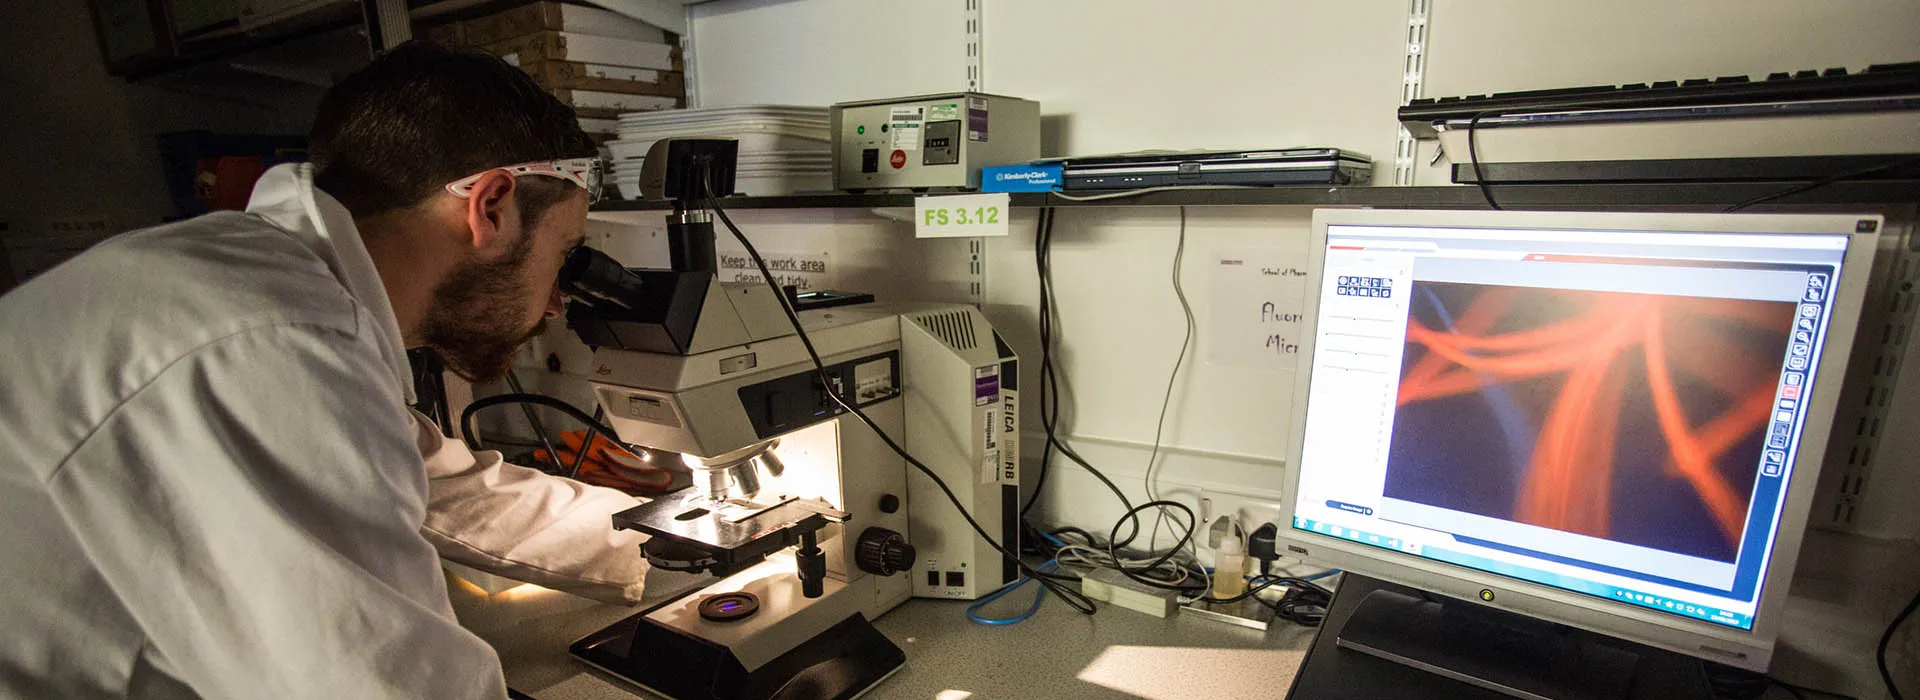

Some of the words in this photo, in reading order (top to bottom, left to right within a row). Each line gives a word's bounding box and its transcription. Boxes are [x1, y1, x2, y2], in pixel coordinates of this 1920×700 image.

[925, 209, 949, 226] FS
[956, 206, 998, 225] 3.12
[720, 255, 746, 269] Keep
[770, 257, 798, 270] work
[800, 260, 825, 272] area
[735, 272, 761, 284] clean
[1261, 301, 1303, 323] Fluor
[1004, 395, 1015, 433] LEICA
